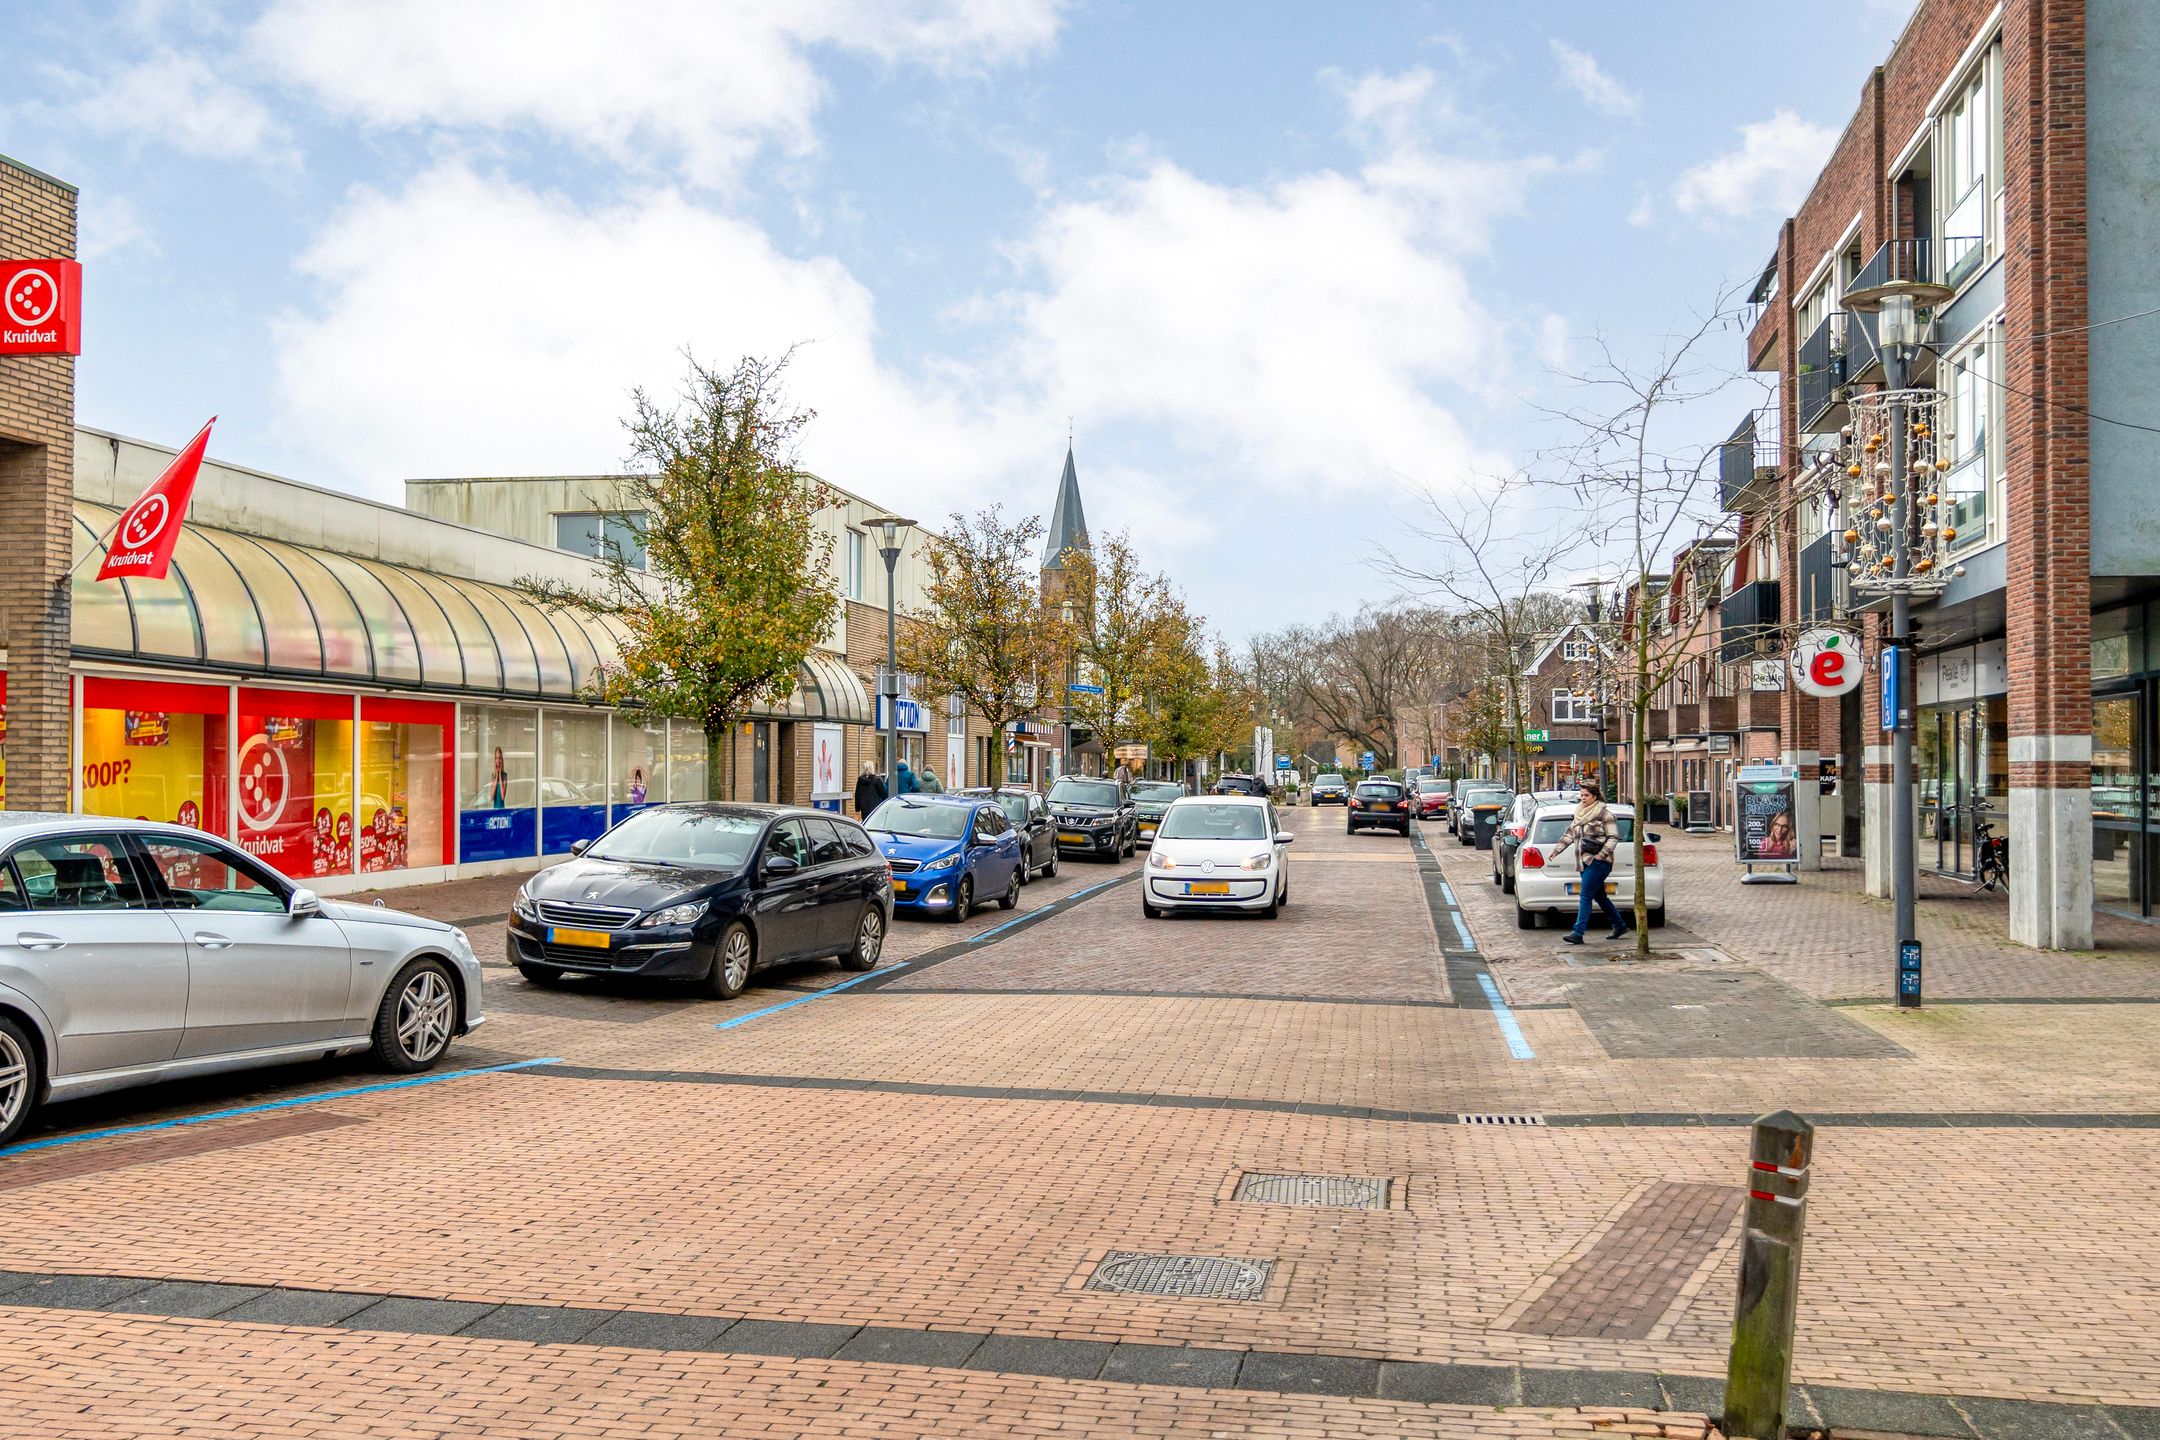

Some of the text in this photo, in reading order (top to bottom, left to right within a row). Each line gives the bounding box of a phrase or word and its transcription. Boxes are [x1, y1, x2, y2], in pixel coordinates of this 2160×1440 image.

[3, 329, 57, 343] Kruidvat
[108, 551, 154, 567] Kruidvat
[1810, 651, 1846, 687] e
[1883, 655, 1891, 695] P
[896, 701, 919, 728] CTION
[1746, 795, 1787, 805] BLACK
[1746, 804, 1787, 814] FRIDAY
[180, 809, 196, 824] 1+1
[318, 815, 331, 829] 1+1
[489, 816, 509, 829] ACTION
